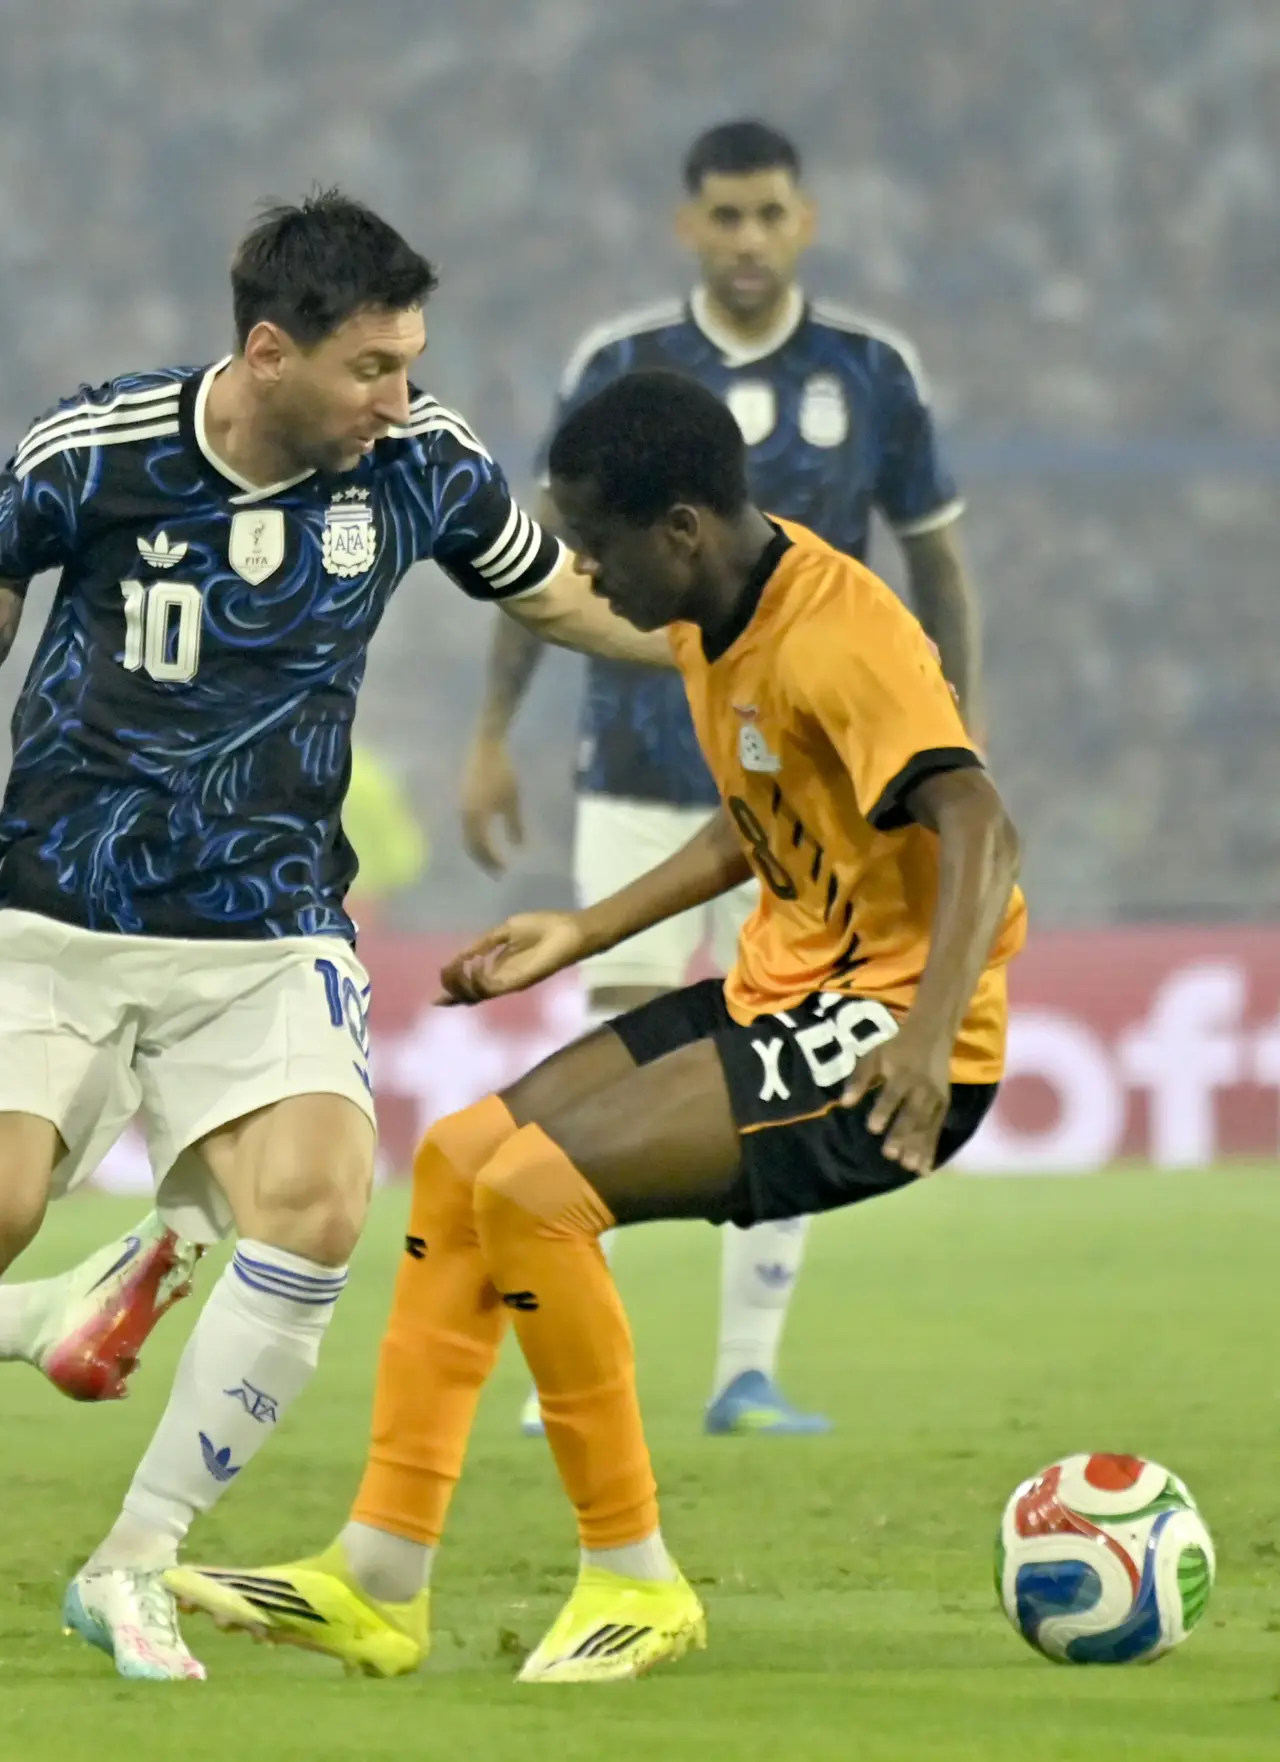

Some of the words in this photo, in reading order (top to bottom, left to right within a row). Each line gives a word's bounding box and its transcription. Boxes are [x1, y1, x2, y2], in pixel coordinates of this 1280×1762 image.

[334, 524, 365, 556] AFA
[244, 556, 269, 566] FIFA
[120, 579, 202, 684] 10
[223, 1378, 278, 1424] AFA
